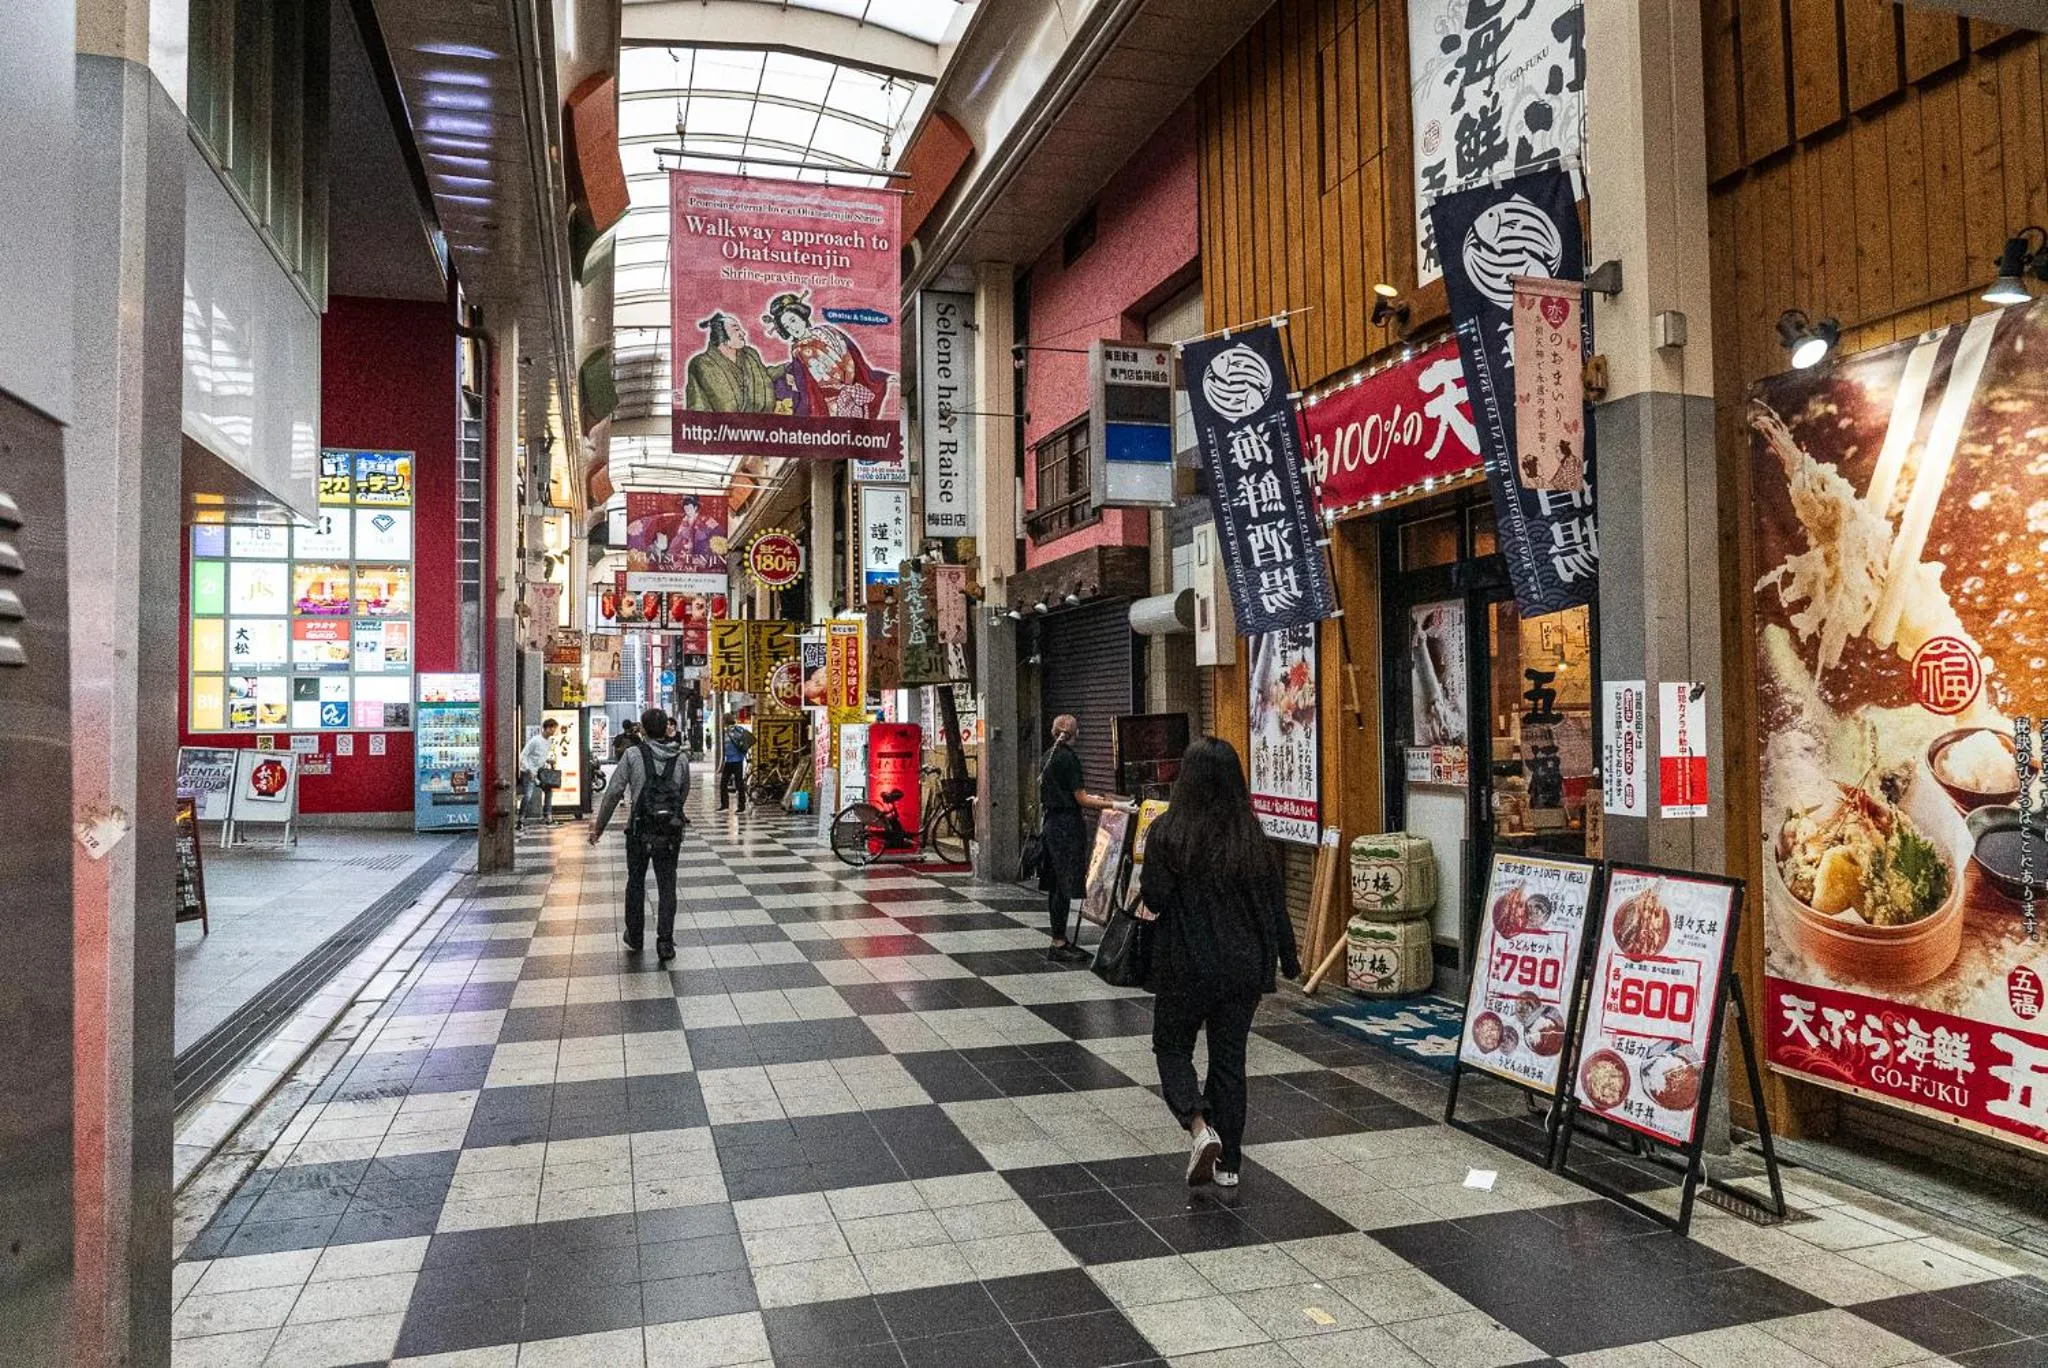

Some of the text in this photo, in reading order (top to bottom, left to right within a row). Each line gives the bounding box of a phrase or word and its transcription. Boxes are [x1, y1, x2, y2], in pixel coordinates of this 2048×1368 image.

[1509, 46, 1551, 83] GO-FUKU
[686, 214, 889, 250] Walkway approach to
[722, 240, 851, 271] Ohatsutenjin
[810, 274, 827, 286] for
[828, 275, 854, 288] love
[1546, 303, 1566, 423] 恋のおまいり
[936, 302, 960, 504] Selene hair Raise
[681, 423, 891, 450] http://www.ohatendori.com/
[927, 512, 967, 527] 梅田店
[870, 523, 889, 565] 謹賀
[755, 554, 797, 573] 180円
[233, 626, 250, 656] 大松
[184, 766, 228, 779] RENTAL
[1499, 953, 1560, 990] 790
[1620, 978, 1695, 1024] 600
[2010, 968, 2041, 1015] 五福
[1780, 994, 1976, 1084] 天ぷら海鮮
[1870, 1064, 1970, 1108] GO-FUKU
